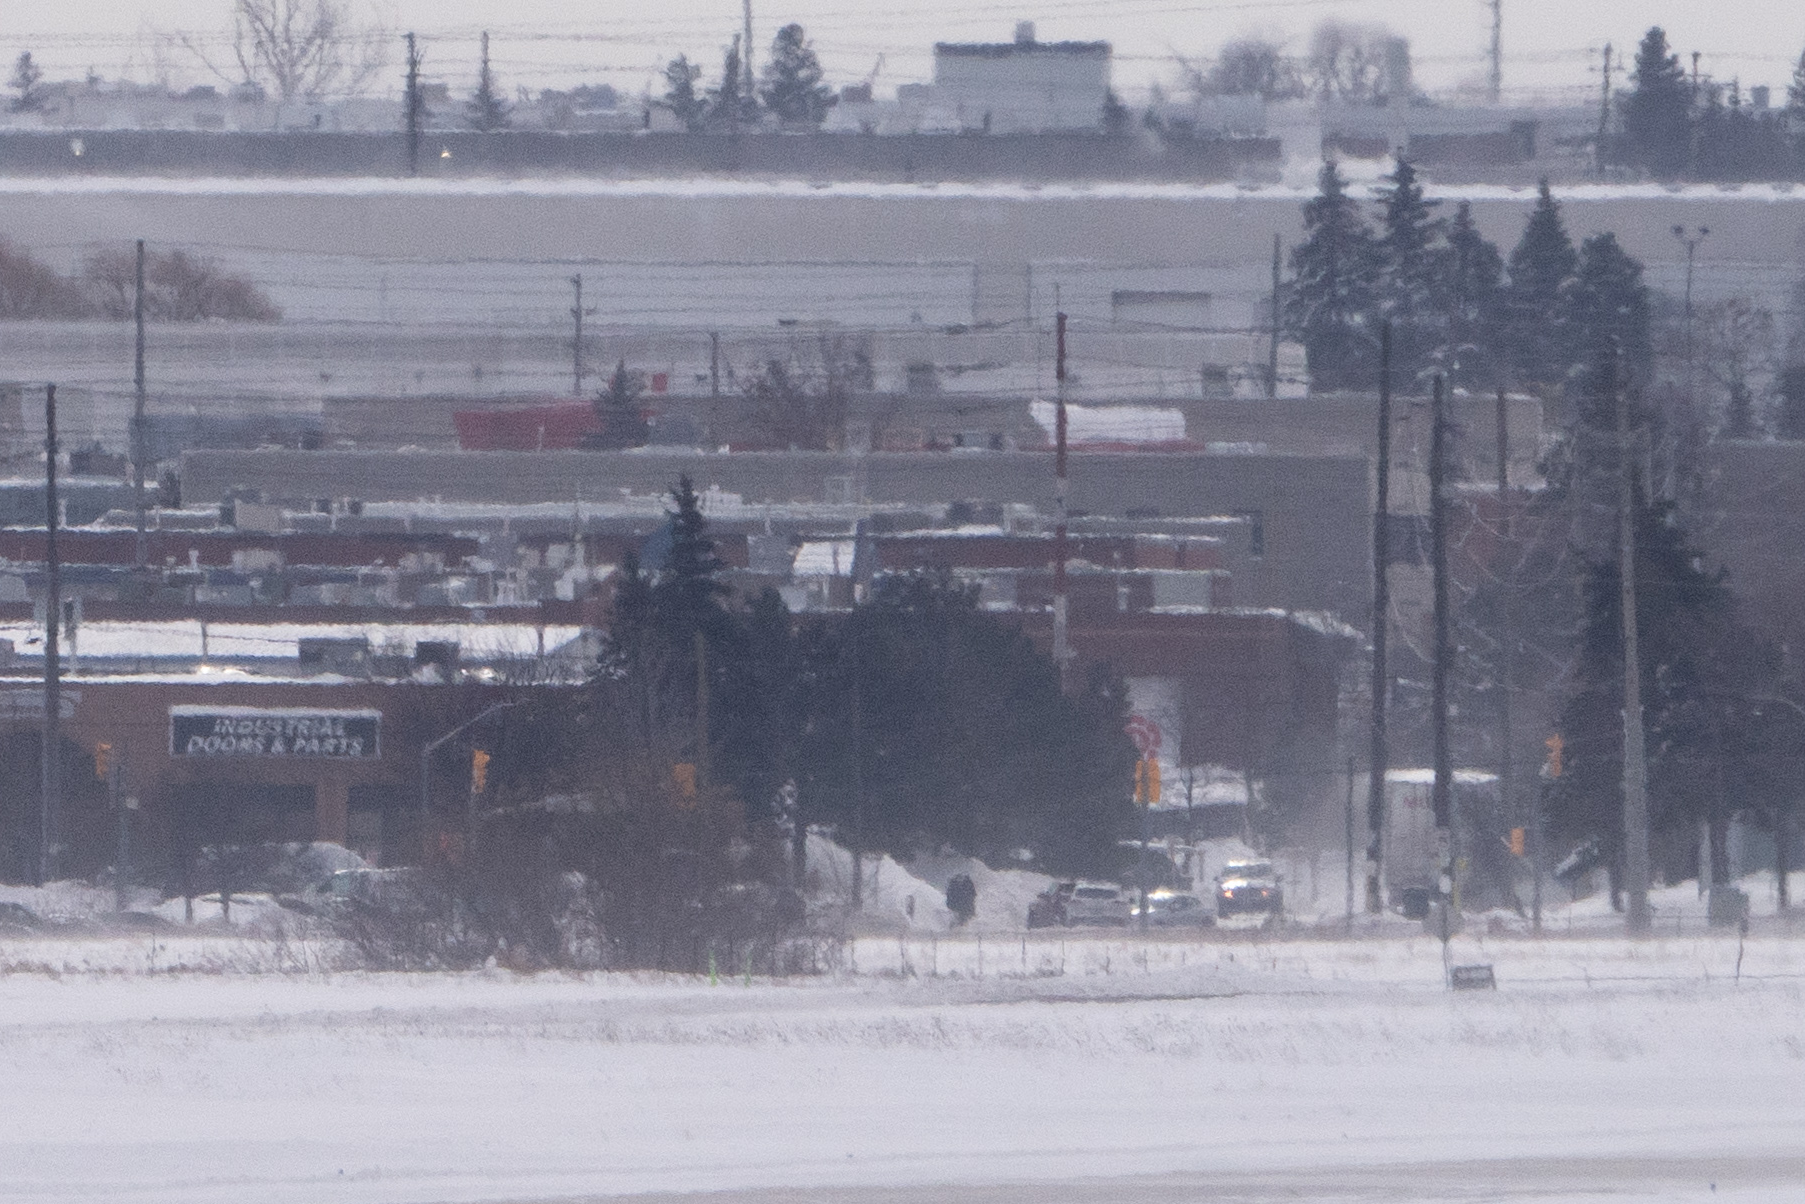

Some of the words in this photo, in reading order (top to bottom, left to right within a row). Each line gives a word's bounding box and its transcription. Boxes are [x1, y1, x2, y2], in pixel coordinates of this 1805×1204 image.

[213, 718, 345, 736] INDUSTRIAL
[187, 736, 264, 754] DOORS
[293, 737, 364, 755] PARTS
